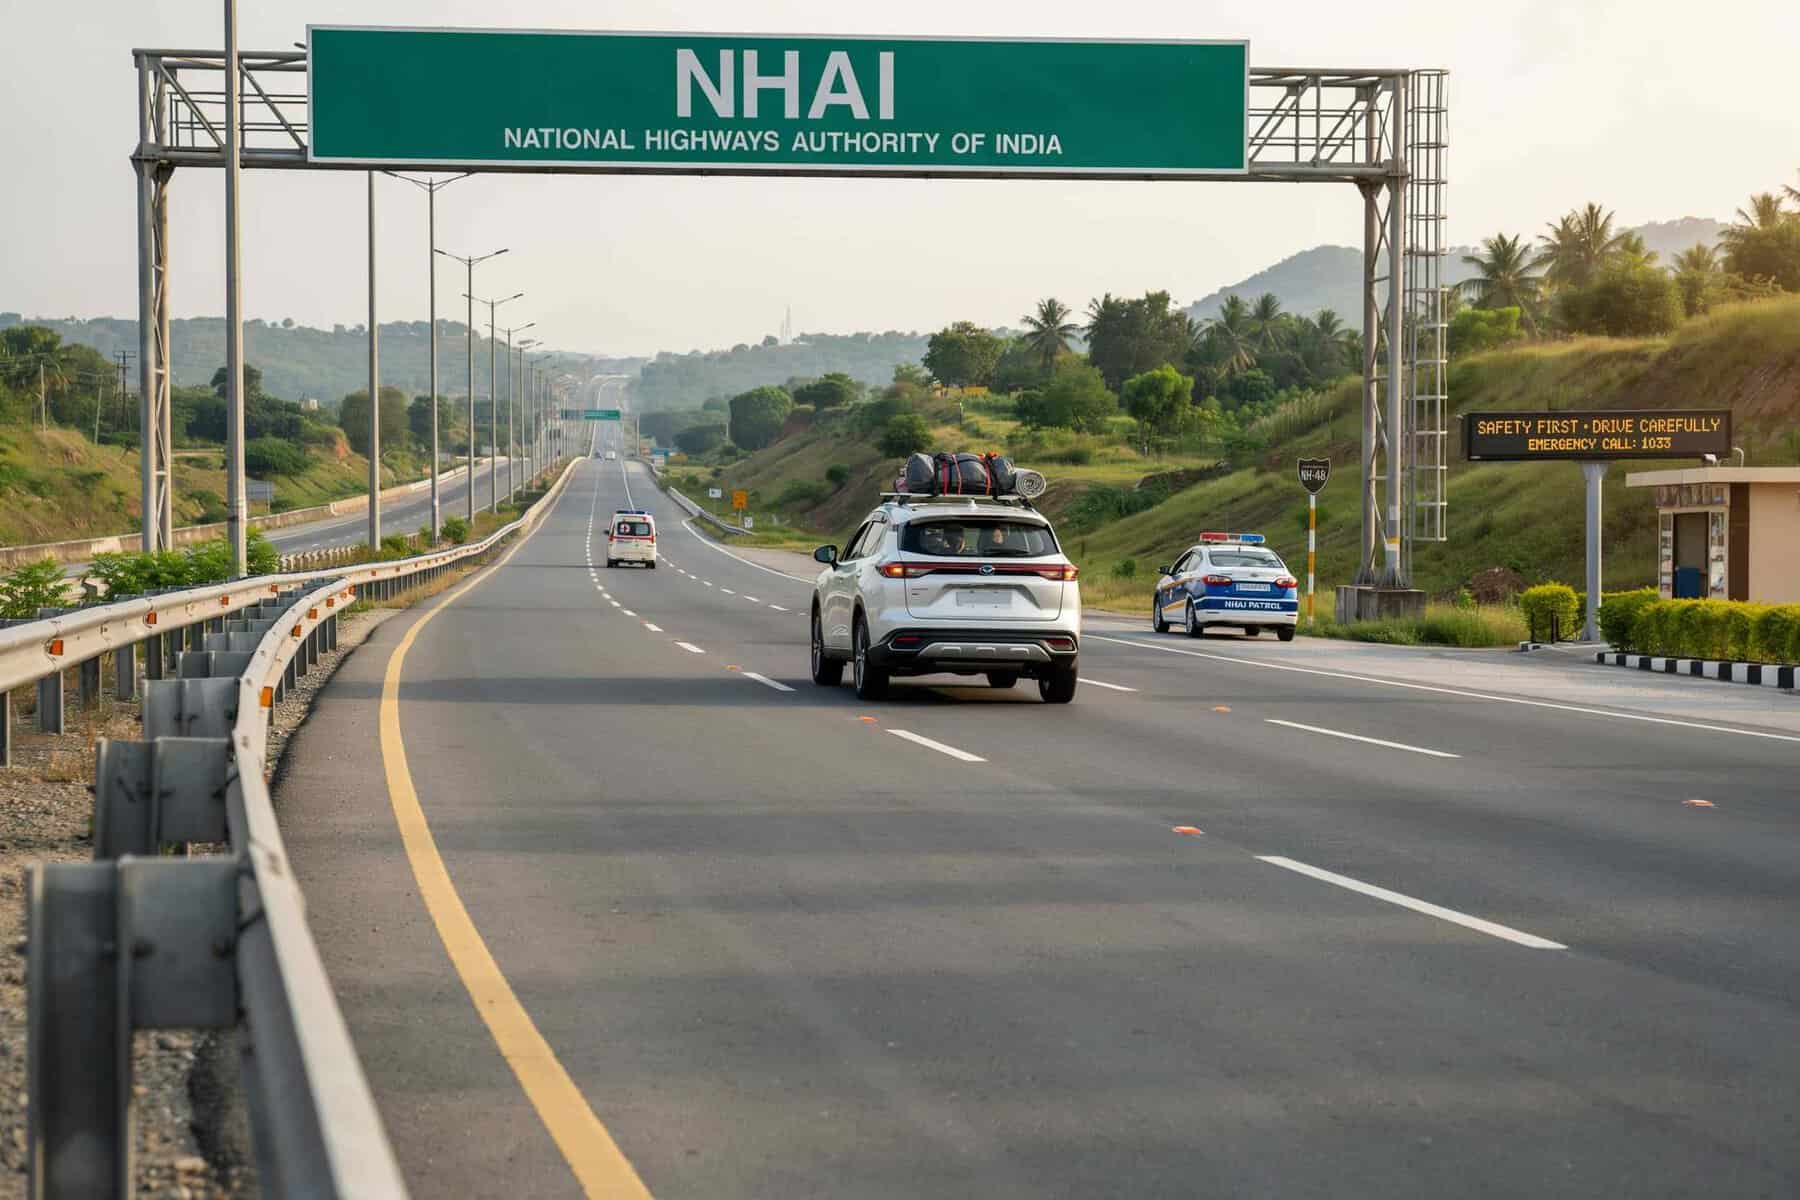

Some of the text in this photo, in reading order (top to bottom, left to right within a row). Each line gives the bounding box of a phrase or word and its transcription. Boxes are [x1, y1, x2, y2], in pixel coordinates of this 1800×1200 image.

[676, 48, 895, 120] NHAI
[504, 127, 1063, 155] NATIONAL HIGHWAYS AUTHORITY OF INDIA
[1478, 418, 1721, 435] SAFETY FIRST DRIVE CAREFULLY
[1528, 436, 1672, 451] EMERGENCY CALL: 1033
[1300, 470, 1326, 480] NH-48
[1248, 601, 1281, 609] PATROL
